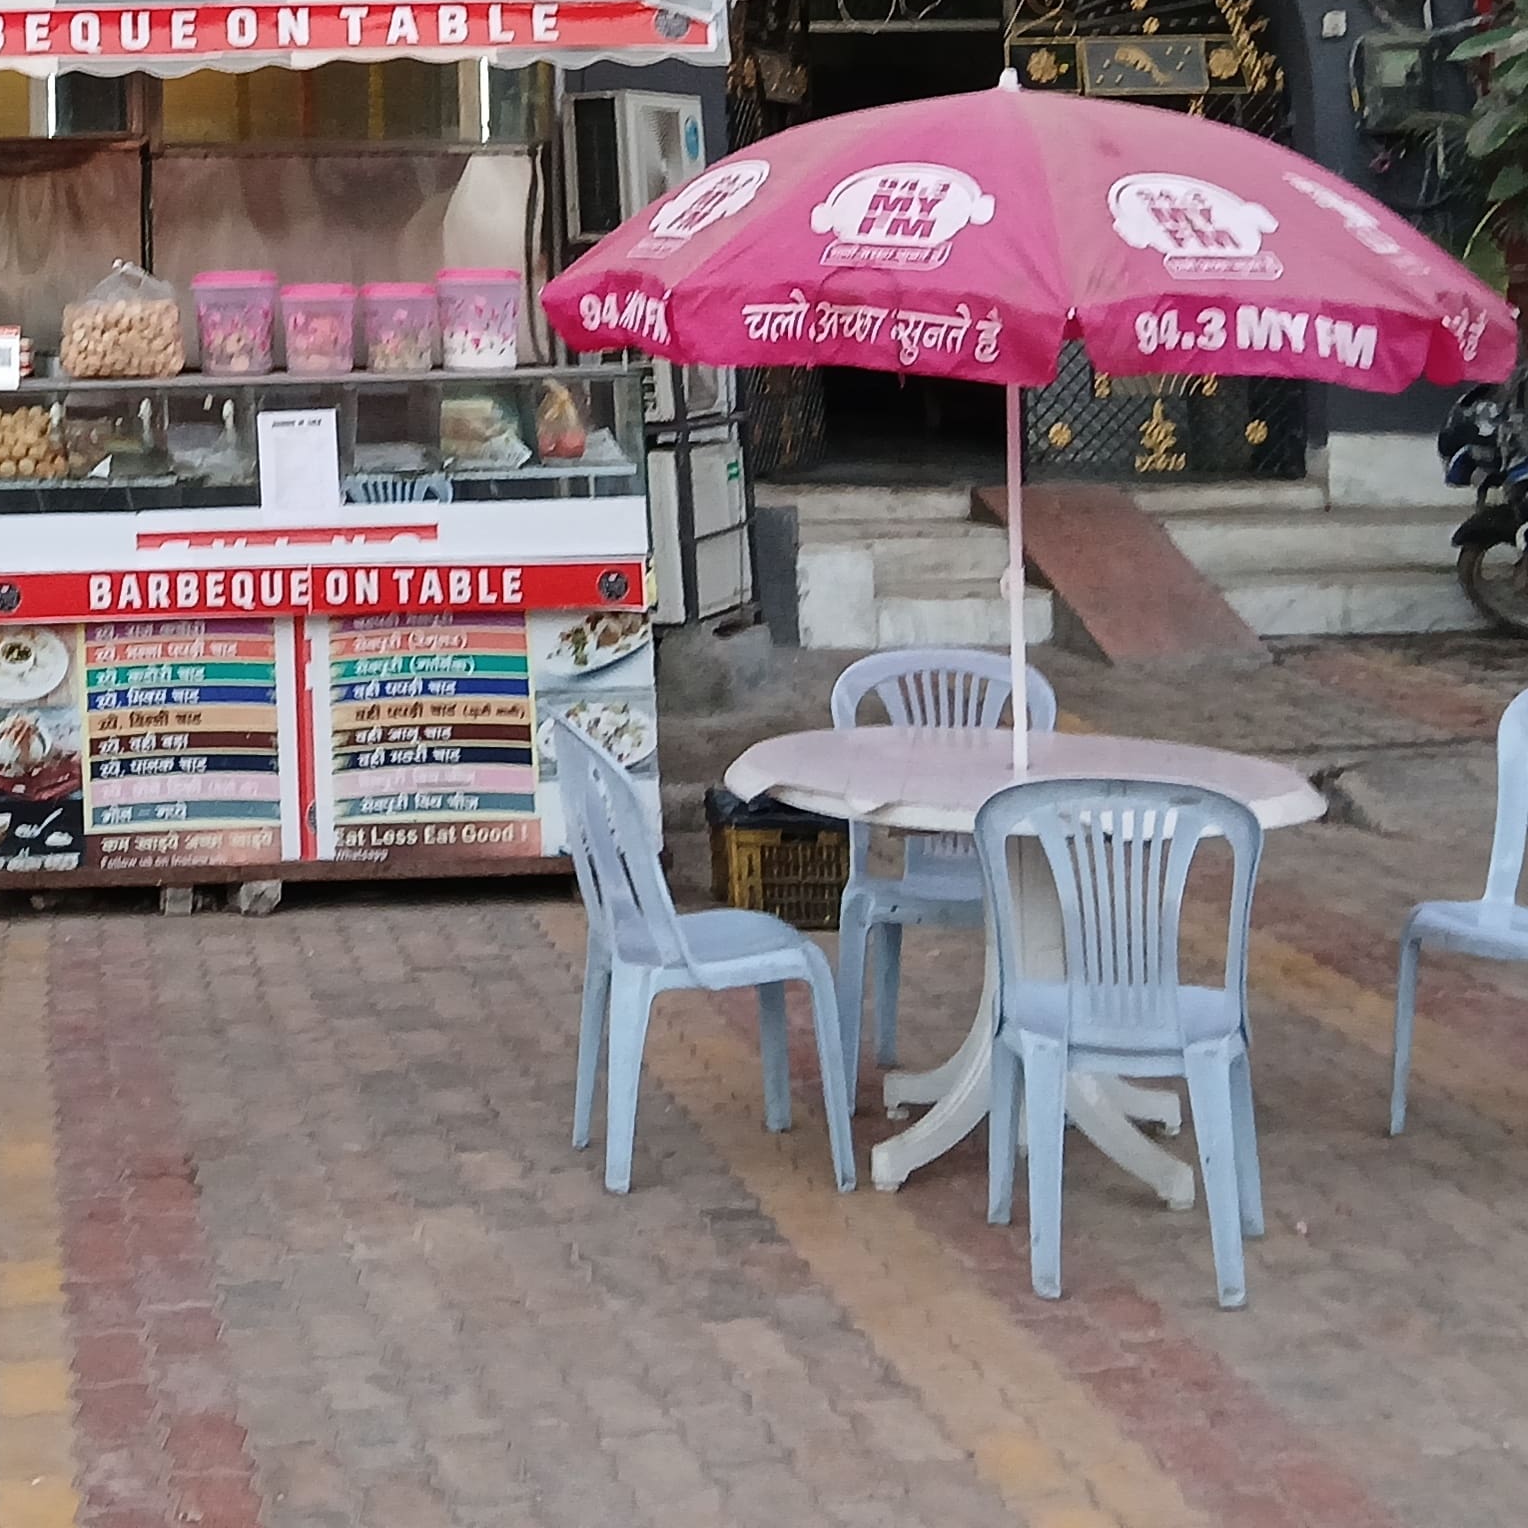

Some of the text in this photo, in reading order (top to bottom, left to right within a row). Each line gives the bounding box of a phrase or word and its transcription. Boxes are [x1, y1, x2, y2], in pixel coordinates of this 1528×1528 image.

[225, 6, 311, 48] ON
[339, 2, 561, 46] TABLE
[867, 194, 942, 214] MY
[741, 287, 810, 344] चलो
[1134, 304, 1379, 370] 94.3 MY FM
[88, 567, 525, 611] BARBEQUE ON TABLE
[369, 825, 419, 846] Less
[423, 824, 457, 845] Eat
[460, 823, 515, 844] Good
